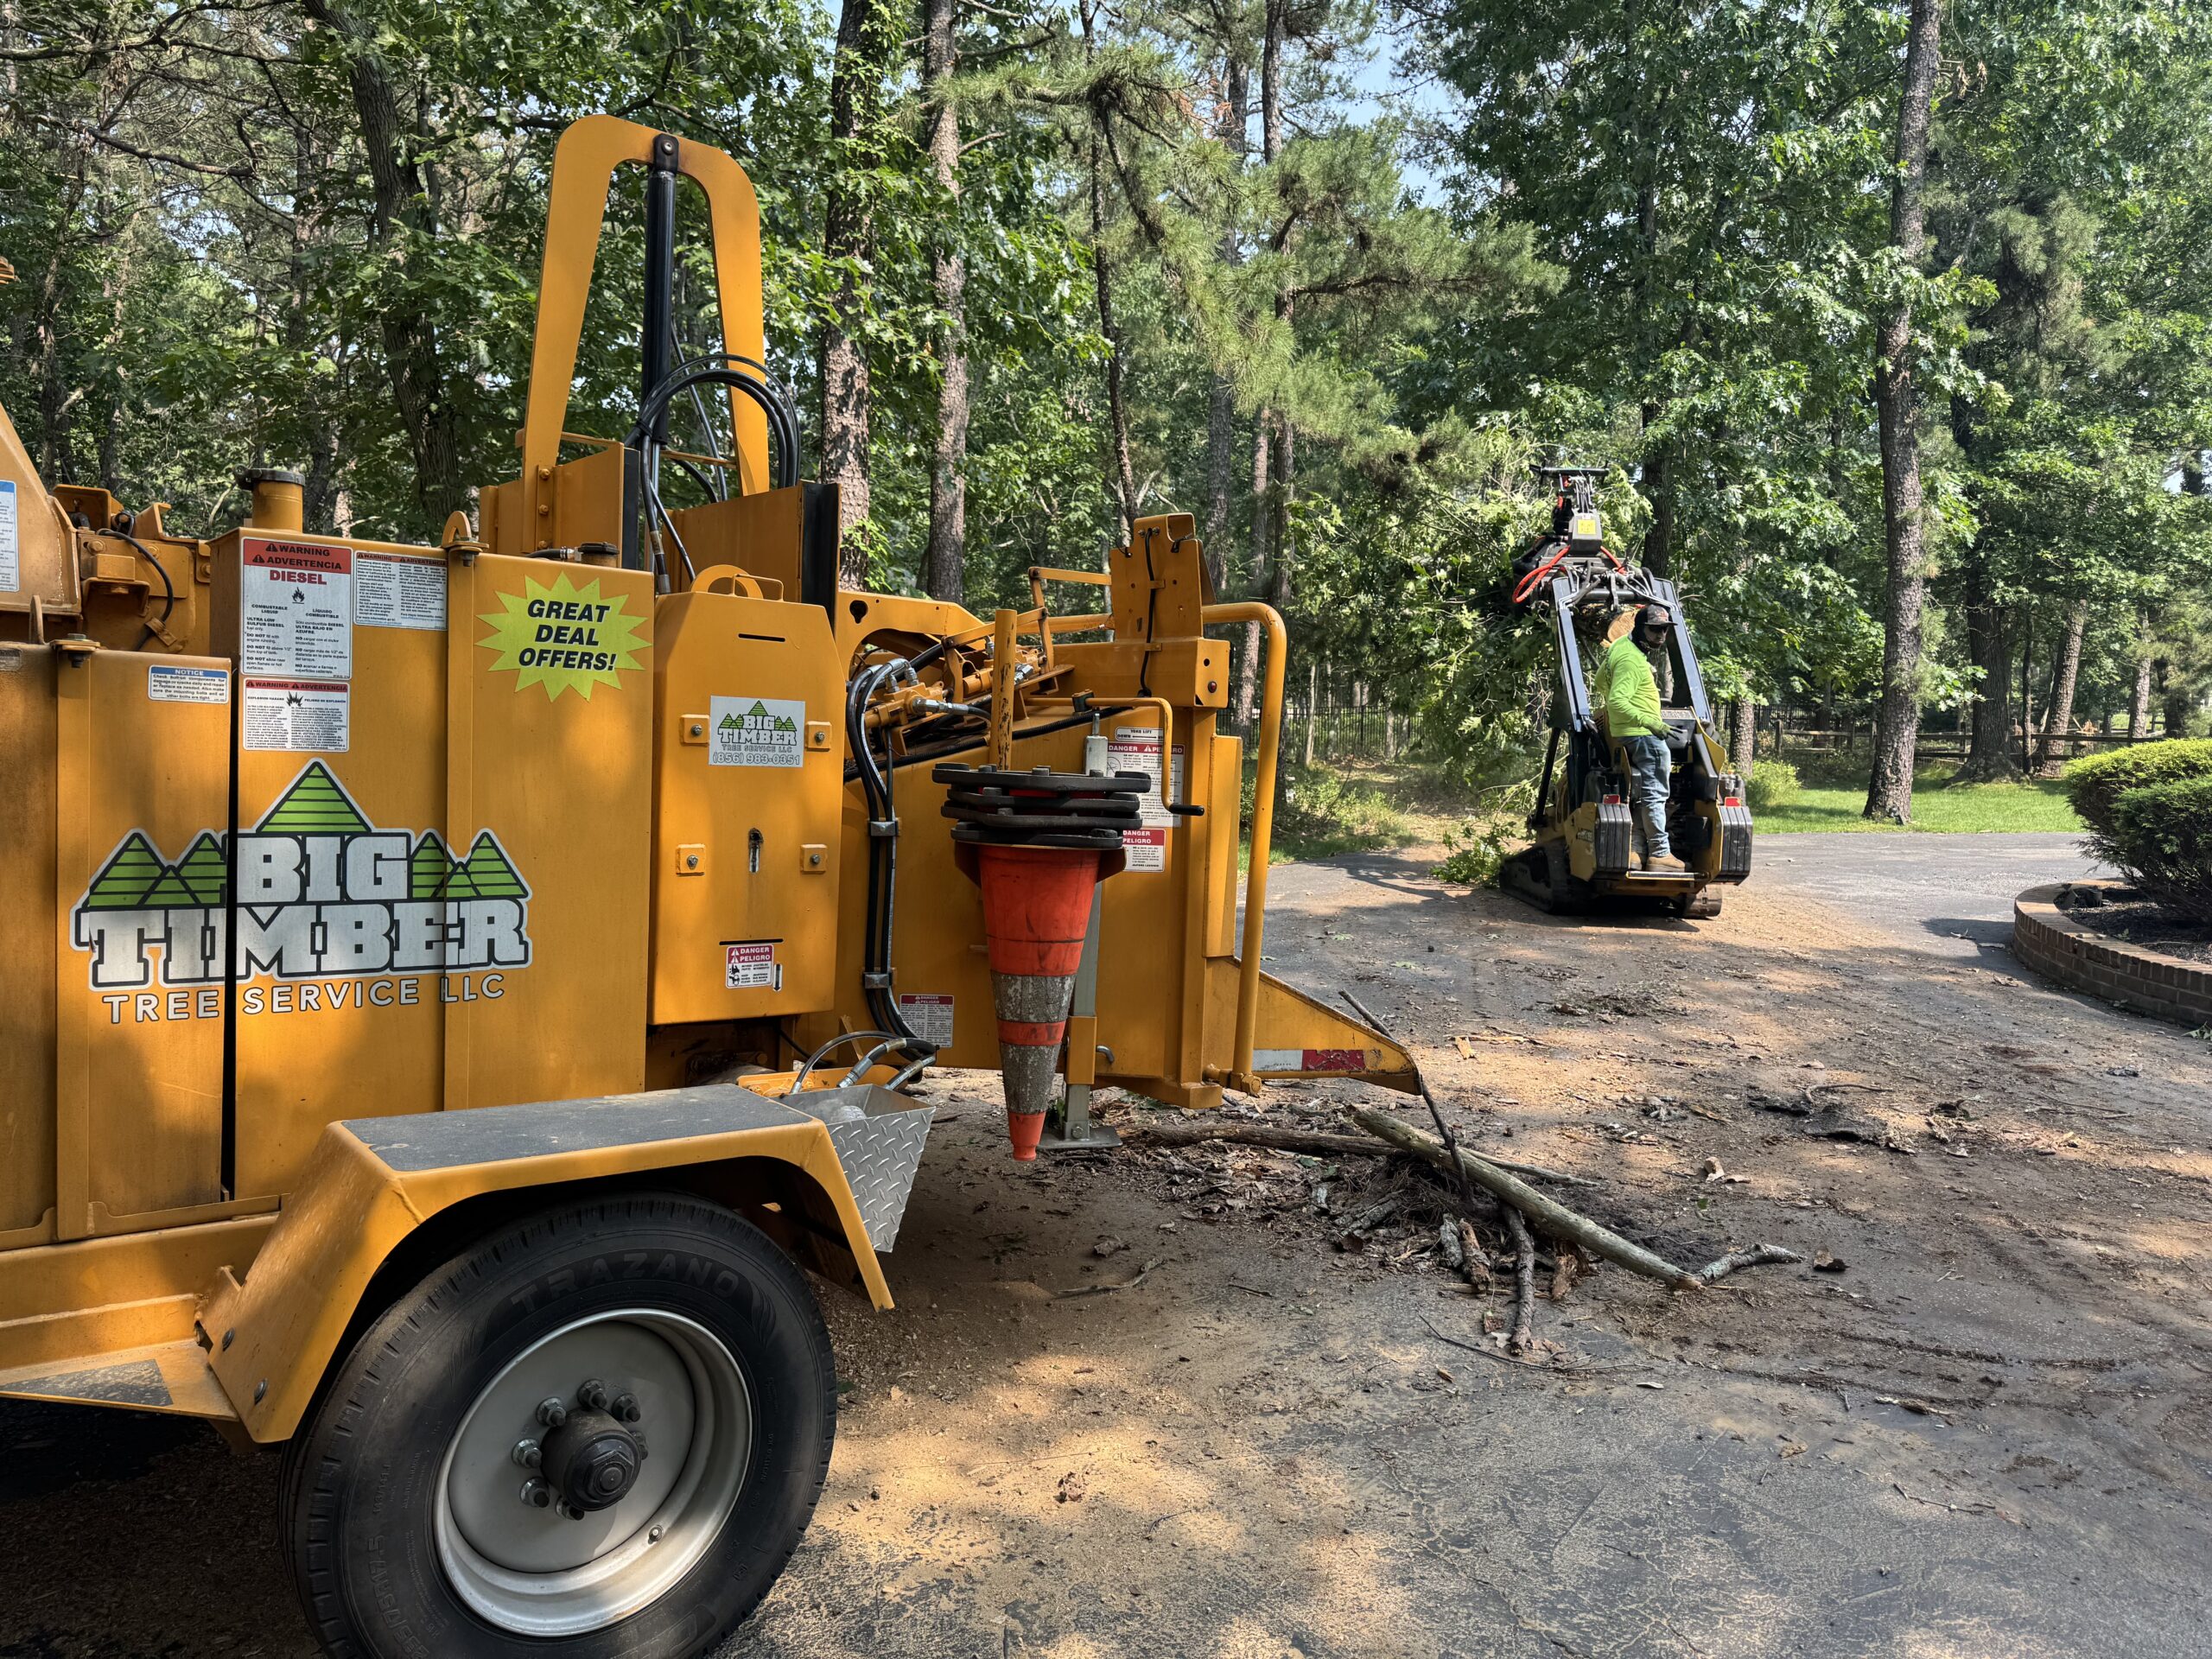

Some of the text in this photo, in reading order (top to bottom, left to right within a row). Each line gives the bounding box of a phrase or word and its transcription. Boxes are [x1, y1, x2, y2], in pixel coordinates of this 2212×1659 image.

[280, 545, 330, 556] WARNING
[267, 556, 341, 569] ADVERTENCIA
[270, 570, 327, 585] DIESEL
[528, 600, 610, 622] GREAT
[535, 625, 599, 645] DEAL
[519, 648, 616, 671] OFFERS!
[743, 715, 775, 730] BIG
[718, 728, 797, 746] TIMBER
[713, 752, 800, 765] (856) 983-0351
[223, 833, 410, 904] BIG
[76, 899, 529, 986] TIMBER
[102, 975, 505, 1023] TREE SERVICE LLC
[511, 1252, 739, 1313] TRAZANO
